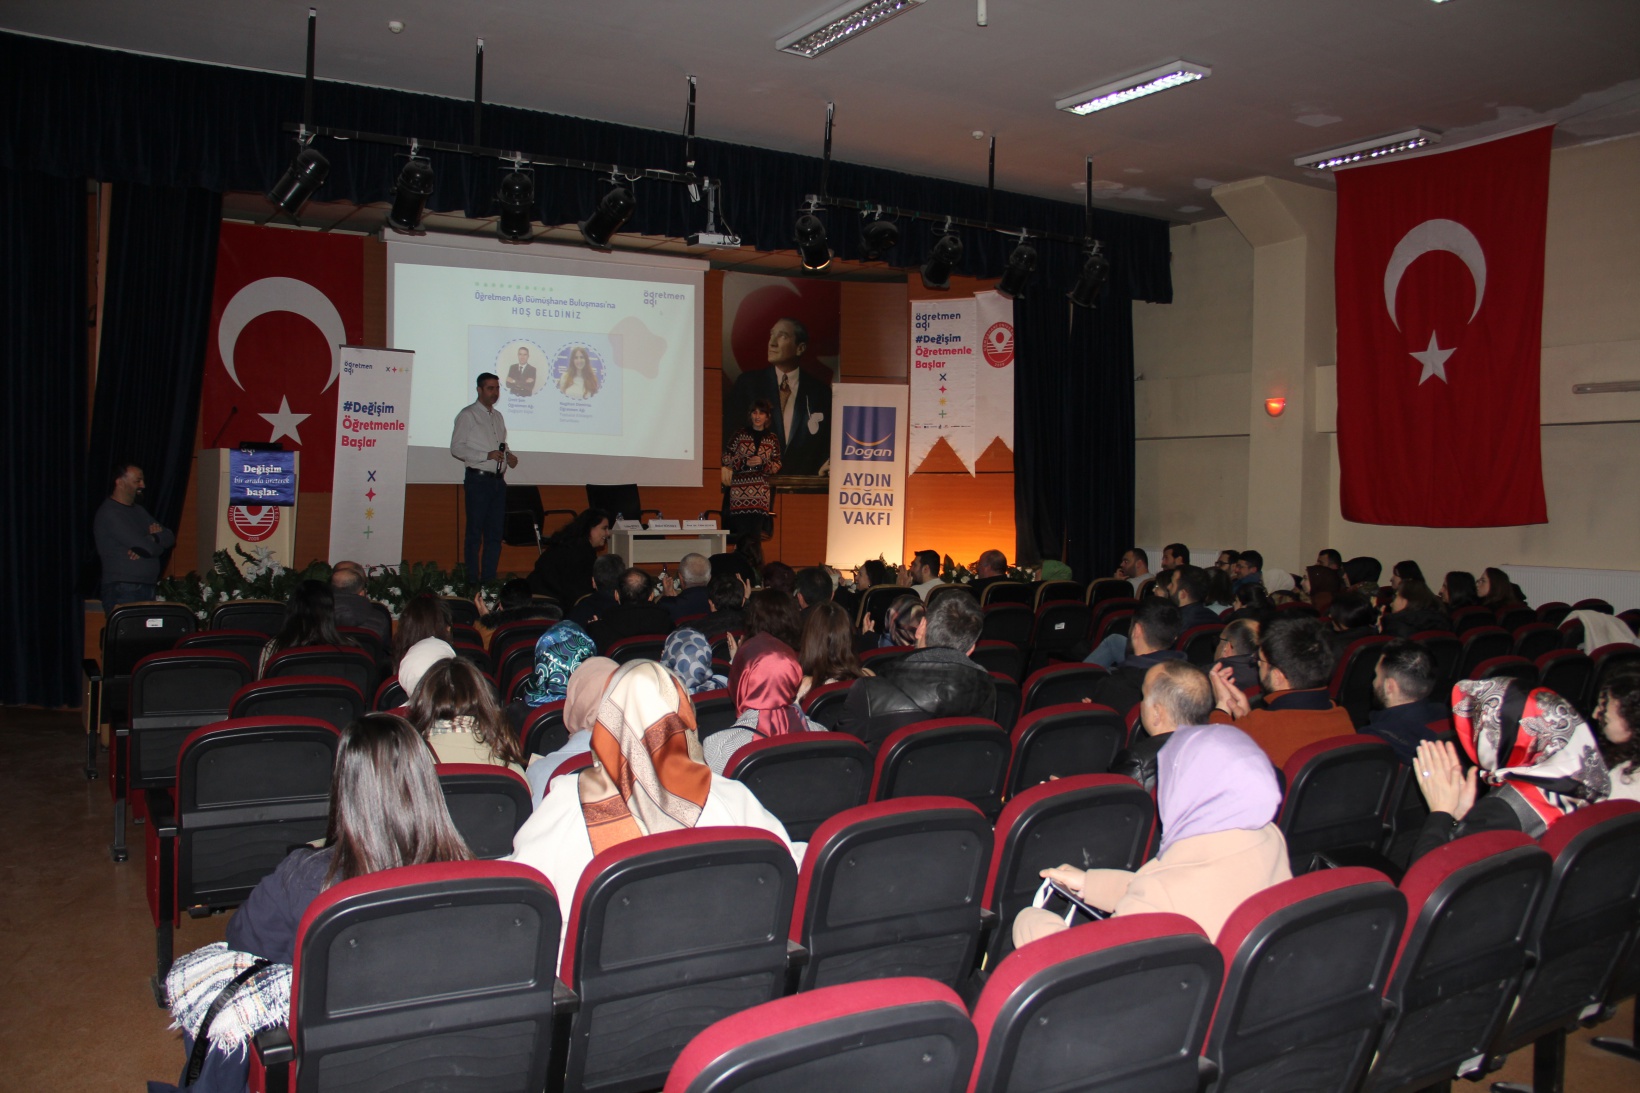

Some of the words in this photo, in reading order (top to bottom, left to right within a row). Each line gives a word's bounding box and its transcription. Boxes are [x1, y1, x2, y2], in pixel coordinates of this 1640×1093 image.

[474, 289, 511, 302] Öğretmen
[512, 294, 524, 304] Ağı
[525, 295, 568, 306] Gümüşhane
[511, 307, 531, 317] HOŞ
[535, 308, 581, 319] GELDİNİZ
[915, 333, 961, 345] #Değişim
[915, 346, 972, 357] Öğretmenle
[915, 360, 946, 371] Başlar
[343, 401, 395, 416] #Değişim
[342, 415, 405, 432] Öğretmenle
[341, 435, 377, 451] Başlar
[243, 464, 282, 475] Değişim
[234, 475, 243, 483] bir
[843, 472, 891, 488] AYDIN
[246, 487, 279, 498] başlar.
[839, 489, 894, 507] DOĞAN
[842, 511, 891, 526] VAKFI
